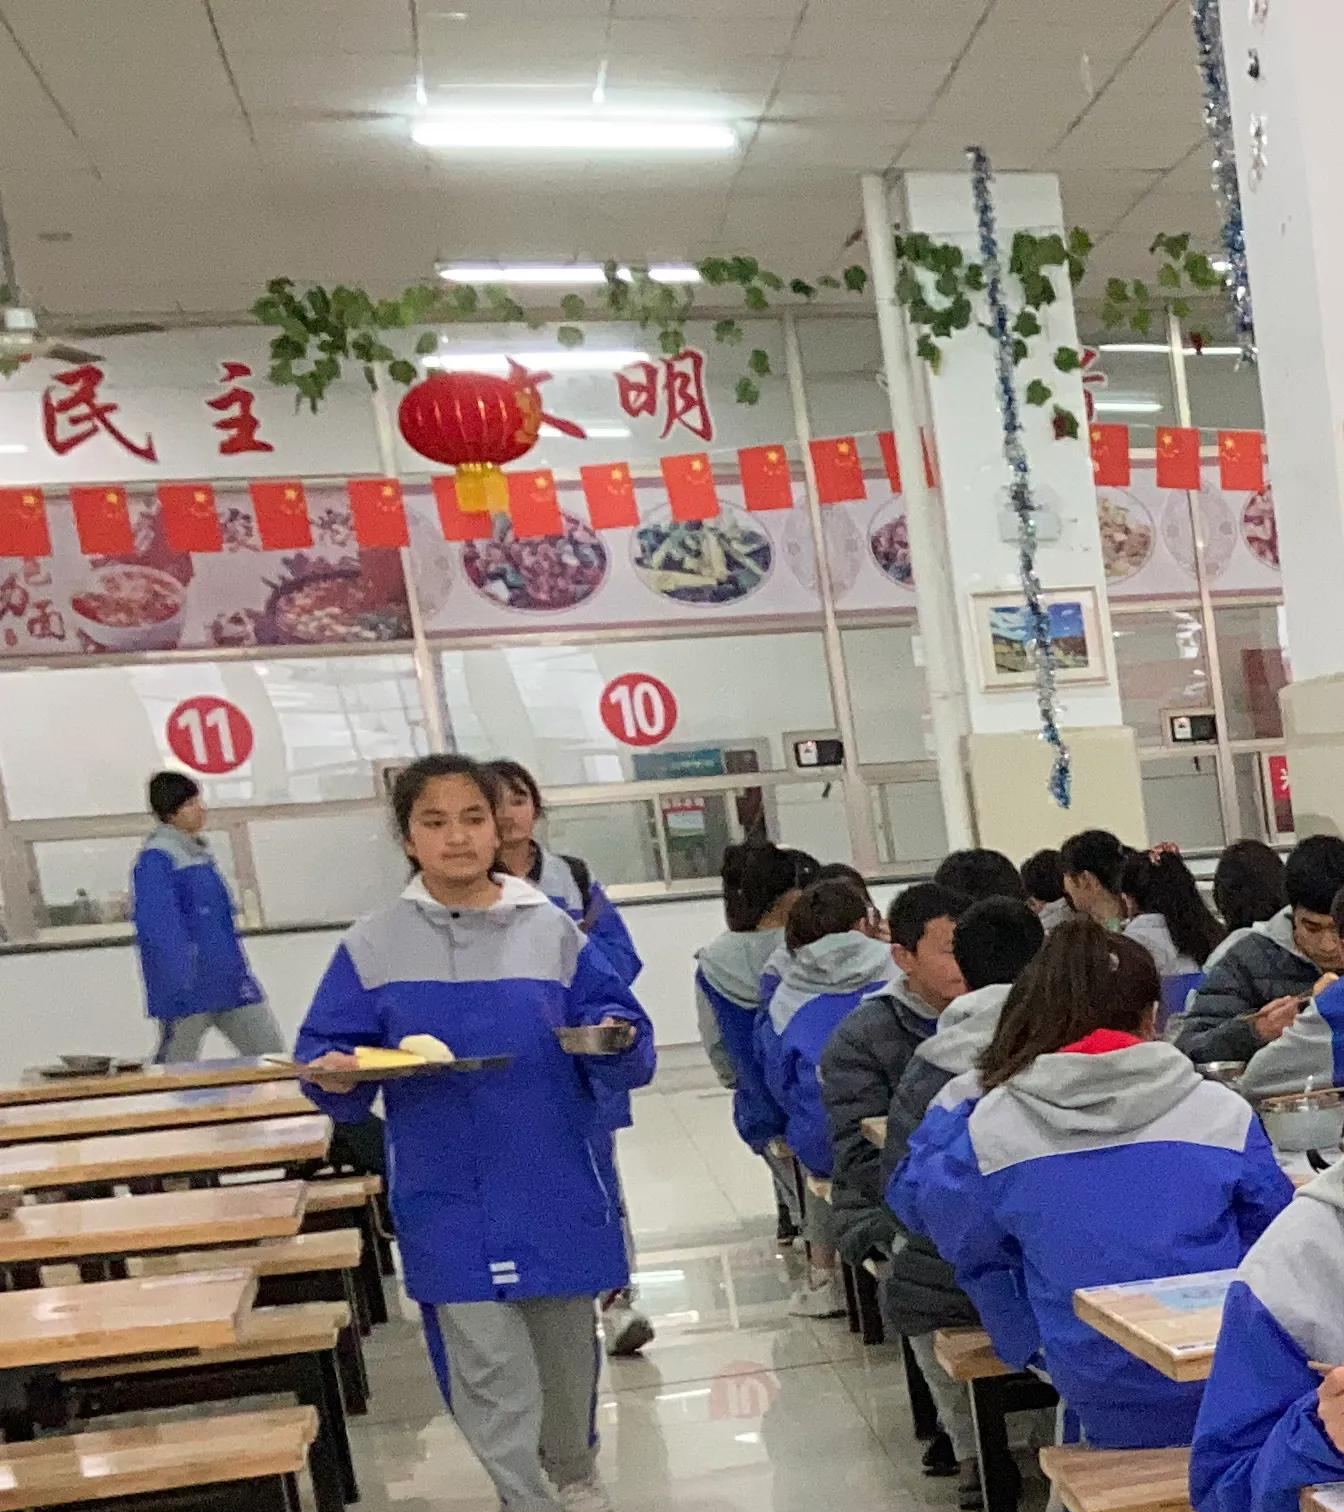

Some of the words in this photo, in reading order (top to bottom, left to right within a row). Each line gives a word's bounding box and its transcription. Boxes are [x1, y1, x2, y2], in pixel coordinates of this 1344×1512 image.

[41, 360, 275, 463] 民主
[176, 706, 237, 765] 11
[609, 681, 667, 739] 10
